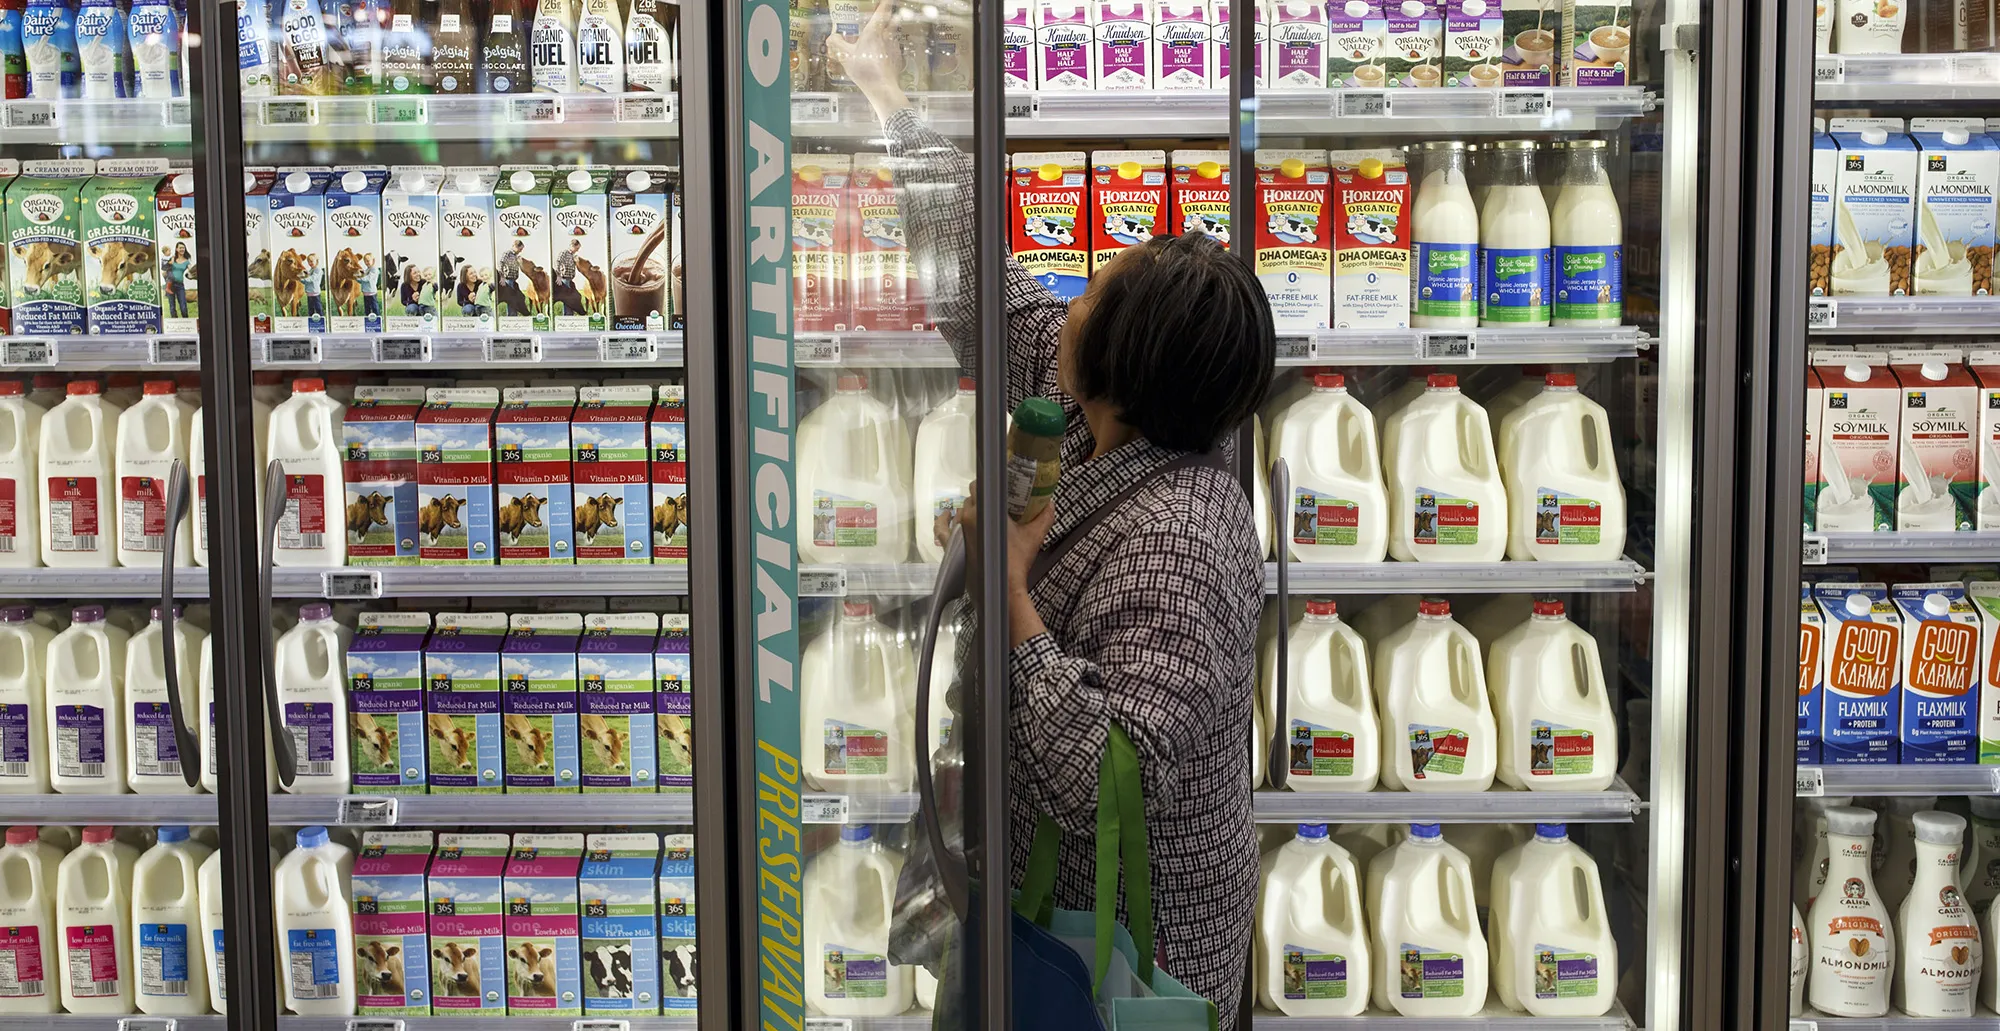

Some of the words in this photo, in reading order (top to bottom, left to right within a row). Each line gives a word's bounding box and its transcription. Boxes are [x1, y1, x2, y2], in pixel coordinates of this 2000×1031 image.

[23, 14, 57, 27] Dairy
[76, 14, 110, 27] Dairy
[128, 12, 166, 26] Dairy
[285, 15, 316, 33] GOOD
[24, 25, 54, 36] Pure
[77, 25, 107, 36] Pure
[132, 24, 162, 36] Pure
[580, 29, 611, 42] ORGANIC
[1047, 28, 1087, 43] Knudsen
[1103, 25, 1144, 40] Knudsen
[1163, 25, 1204, 40] Knudsen
[533, 30, 563, 43] ORGANIC
[1338, 36, 1376, 46] ORGANIC
[747, 4, 783, 87] O
[1343, 42, 1372, 51] VALLEY
[483, 45, 521, 61] Belgian
[533, 43, 566, 66] FUEL
[580, 43, 613, 65] FUEL
[628, 42, 661, 64] FUEL
[1505, 72, 1522, 80] Half
[1522, 72, 1528, 80] &
[1528, 72, 1540, 80] Half
[32, 113, 49, 121] $1.59
[1849, 160, 1862, 170] 365
[1931, 160, 1944, 170] 365
[1846, 184, 1909, 195] ALMONDMILK
[1928, 184, 1992, 195] ALMONDMILK
[23, 198, 60, 207] ORGANIC
[98, 198, 135, 207] ORGANIC
[1019, 192, 1080, 207] HORIZON
[1099, 190, 1160, 205] HORIZON
[1263, 190, 1324, 204] HORIZON
[1342, 190, 1403, 204] HORIZON
[27, 205, 56, 214] VALLEY
[102, 205, 131, 214] VALLEY
[1026, 205, 1075, 216] ORGANIC
[1106, 204, 1154, 214] ORGANIC
[1270, 204, 1318, 212] ORGANIC
[1349, 205, 1397, 213] ORGANIC
[280, 219, 312, 230] VALLEY
[12, 226, 76, 239] GRASSMILK
[88, 225, 150, 239] GRASSMILK
[1018, 253, 1038, 264] DHA
[1040, 252, 1085, 263] OMEGA-3
[1260, 250, 1281, 261] DHA
[1282, 250, 1327, 261] OMEGA-3
[1339, 251, 1361, 262] DHA
[1362, 251, 1406, 262] OMEGA-3
[1262, 260, 1288, 268] Supports
[1498, 258, 1514, 268] Saint
[1517, 259, 1535, 268] Benoit
[49, 312, 61, 320] Fat
[63, 312, 81, 320] Milk
[138, 312, 156, 320] Milk
[1810, 312, 1827, 320] $2.99
[615, 322, 645, 330] Chocolate
[1450, 344, 1467, 352] $4.99
[29, 351, 46, 359] $5.99
[749, 119, 793, 704] ARTIFICIAL
[1833, 421, 1888, 433] SOYMILK
[1912, 420, 1967, 432] SOYMILK
[350, 449, 366, 459] 365
[424, 452, 440, 461] 365
[504, 451, 520, 460] 365
[514, 475, 542, 483] Vitamin
[552, 474, 569, 482] Milk
[590, 475, 618, 483] Vitamin
[628, 474, 645, 482] Milk
[64, 488, 82, 497] milk
[136, 488, 154, 497] milk
[292, 486, 309, 495] milk
[820, 581, 838, 589] $5.99
[1843, 625, 1890, 665] GOOD
[1922, 625, 1970, 665] GOOD
[1838, 662, 1886, 690] KARMA
[1916, 662, 1964, 690] KARMA
[358, 700, 388, 709] Reduced
[389, 700, 400, 708] Fat
[402, 700, 418, 708] Milk
[437, 702, 466, 710] Reduced
[481, 701, 497, 709] Milk
[1839, 702, 1888, 716] FLAXMILK
[1917, 702, 1966, 716] FLAXMILK
[1854, 720, 1877, 728] PROTEIN
[1932, 720, 1956, 728] PROTEIN
[1833, 729, 1840, 737] 8g
[1912, 729, 1919, 737] 8g
[758, 739, 803, 1031] PRESERVAT
[382, 927, 406, 935] Lowfat
[408, 925, 424, 934] Milk
[1835, 921, 1880, 931] ORIGINAL
[459, 928, 482, 936] Lowfat
[559, 928, 576, 936] Milk
[1821, 956, 1890, 970] ALMONDMILK
